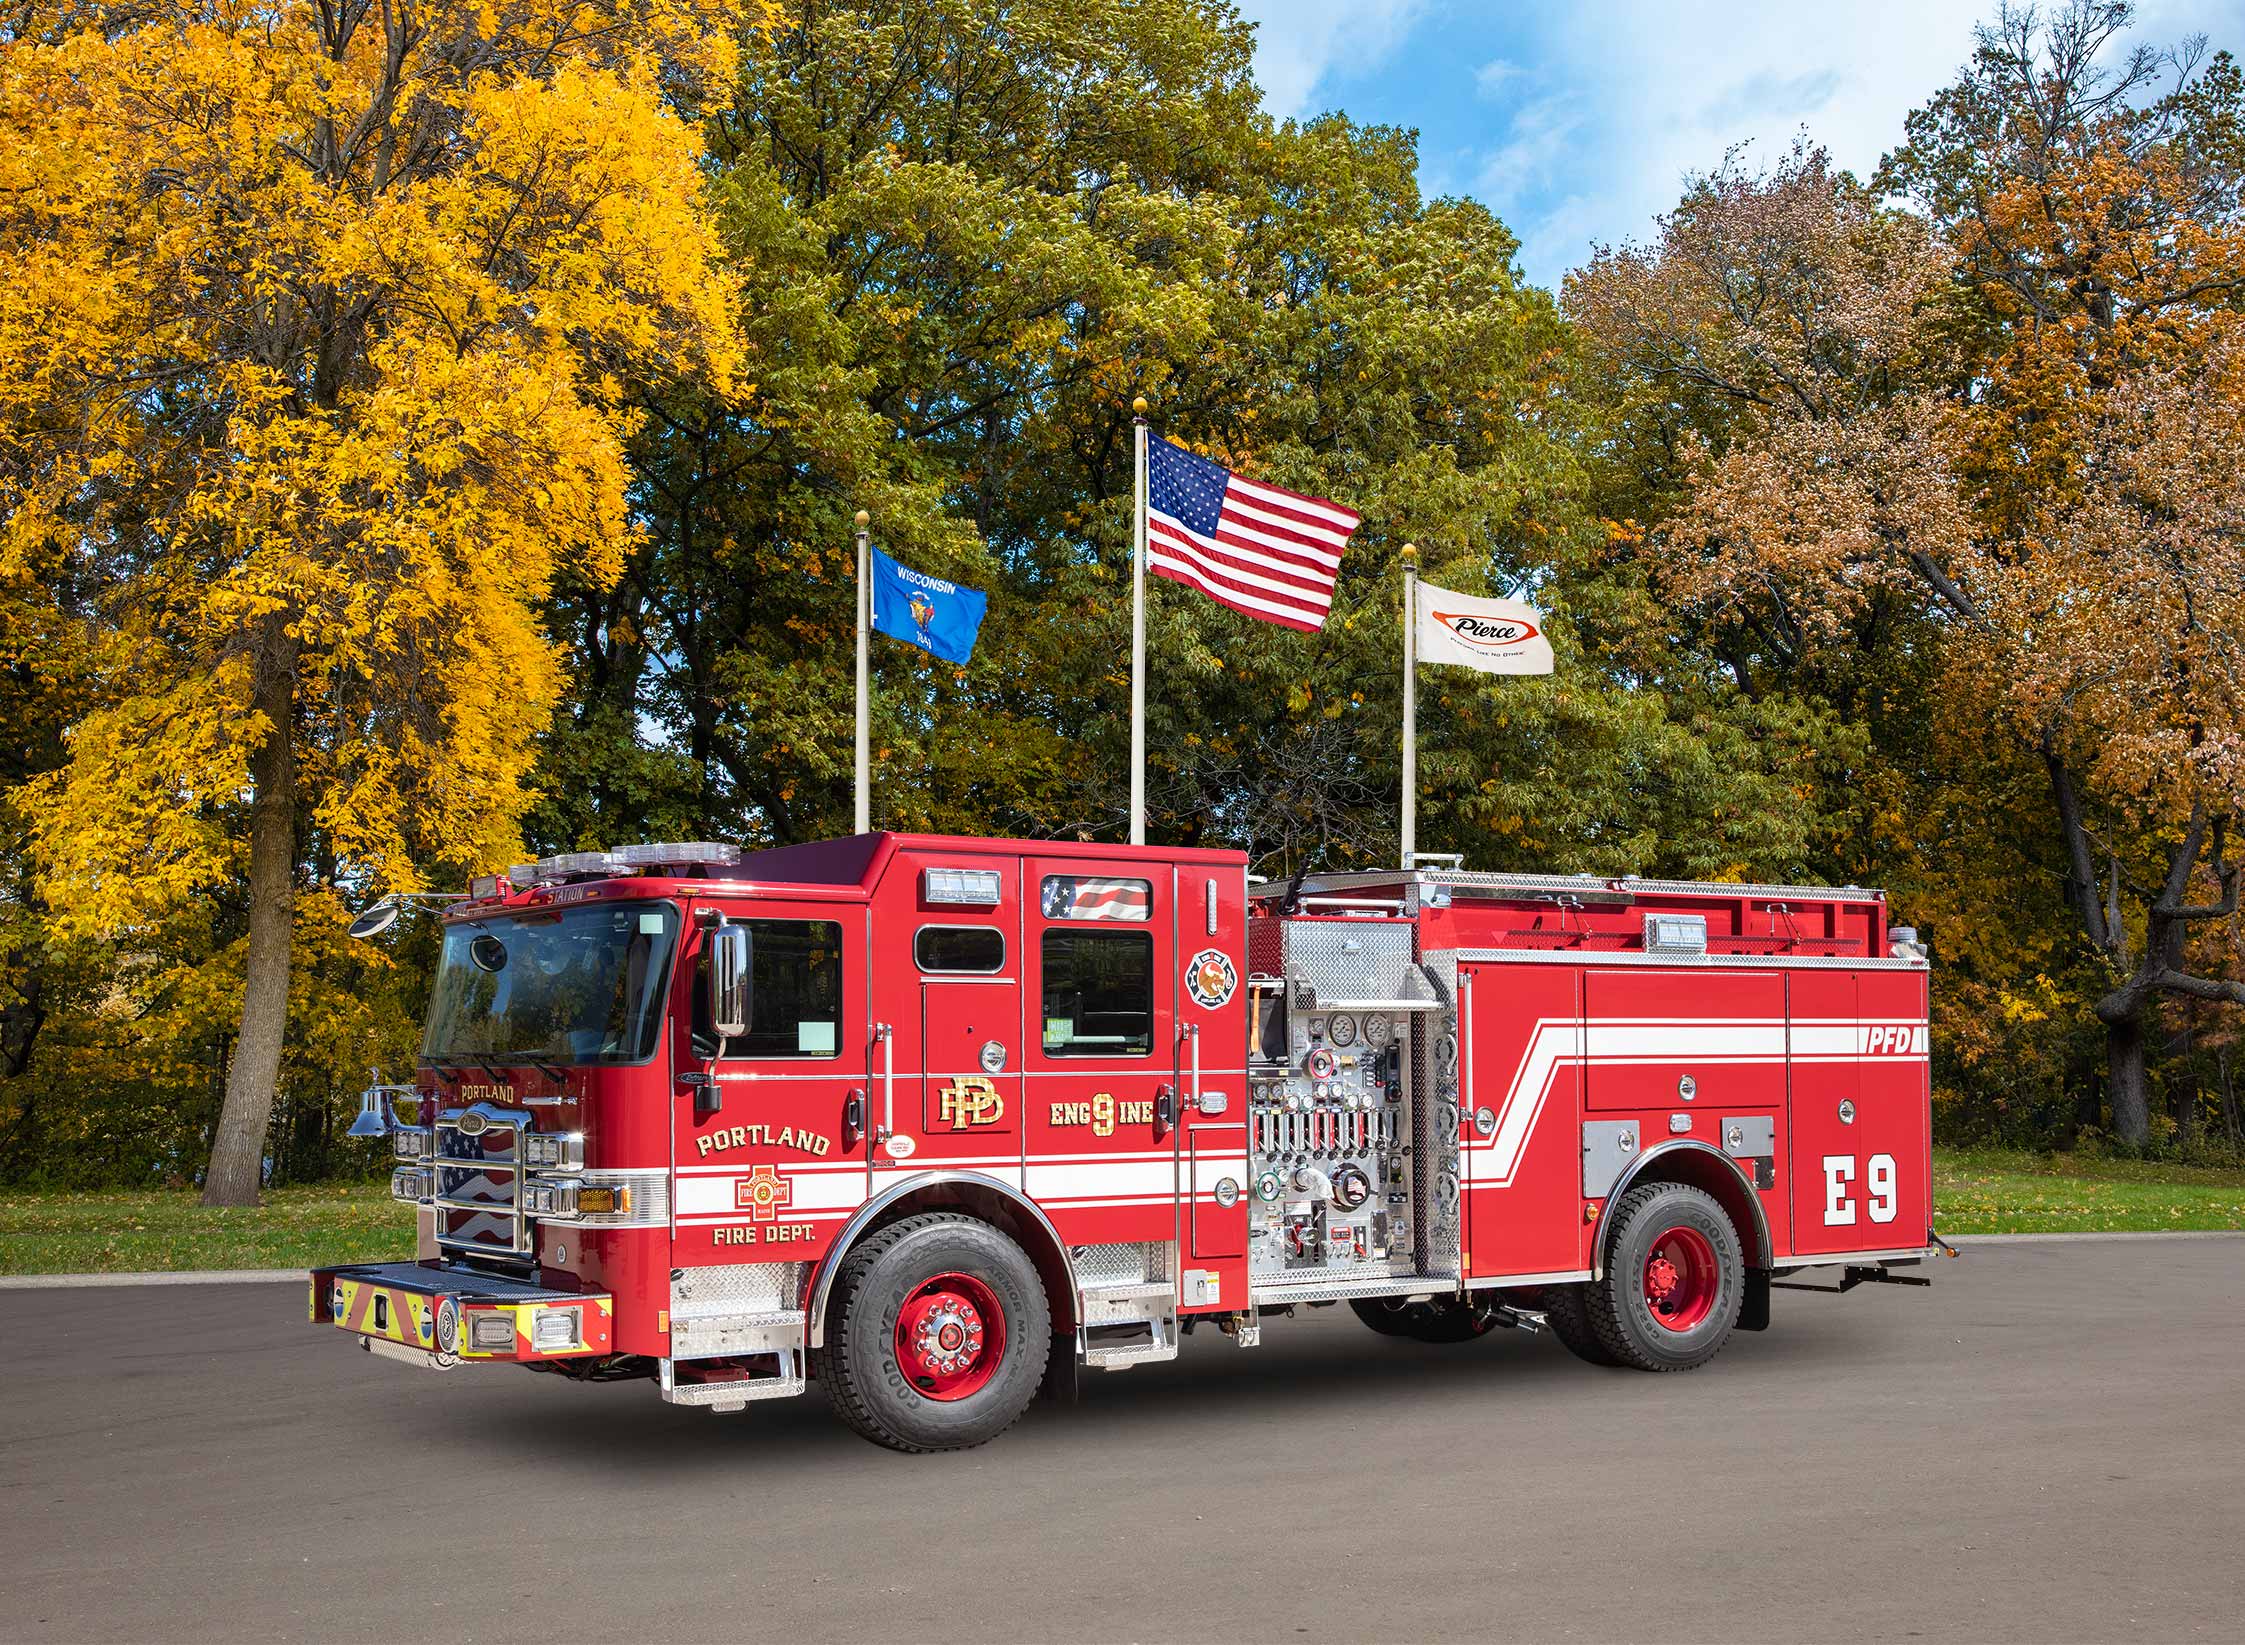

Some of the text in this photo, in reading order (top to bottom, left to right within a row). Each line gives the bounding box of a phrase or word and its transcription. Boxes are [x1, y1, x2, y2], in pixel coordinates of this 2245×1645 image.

[897, 566, 956, 594] WISCONSIN
[1455, 618, 1516, 639] Pierce
[546, 886, 585, 904] STATION
[1868, 1026, 1911, 1054] PFD
[461, 1084, 514, 1104] PORTLAND
[695, 1124, 831, 1157] PORTLAND
[713, 1223, 816, 1245] FIRE DEPT.
[1014, 1319, 1026, 1359] MAX
